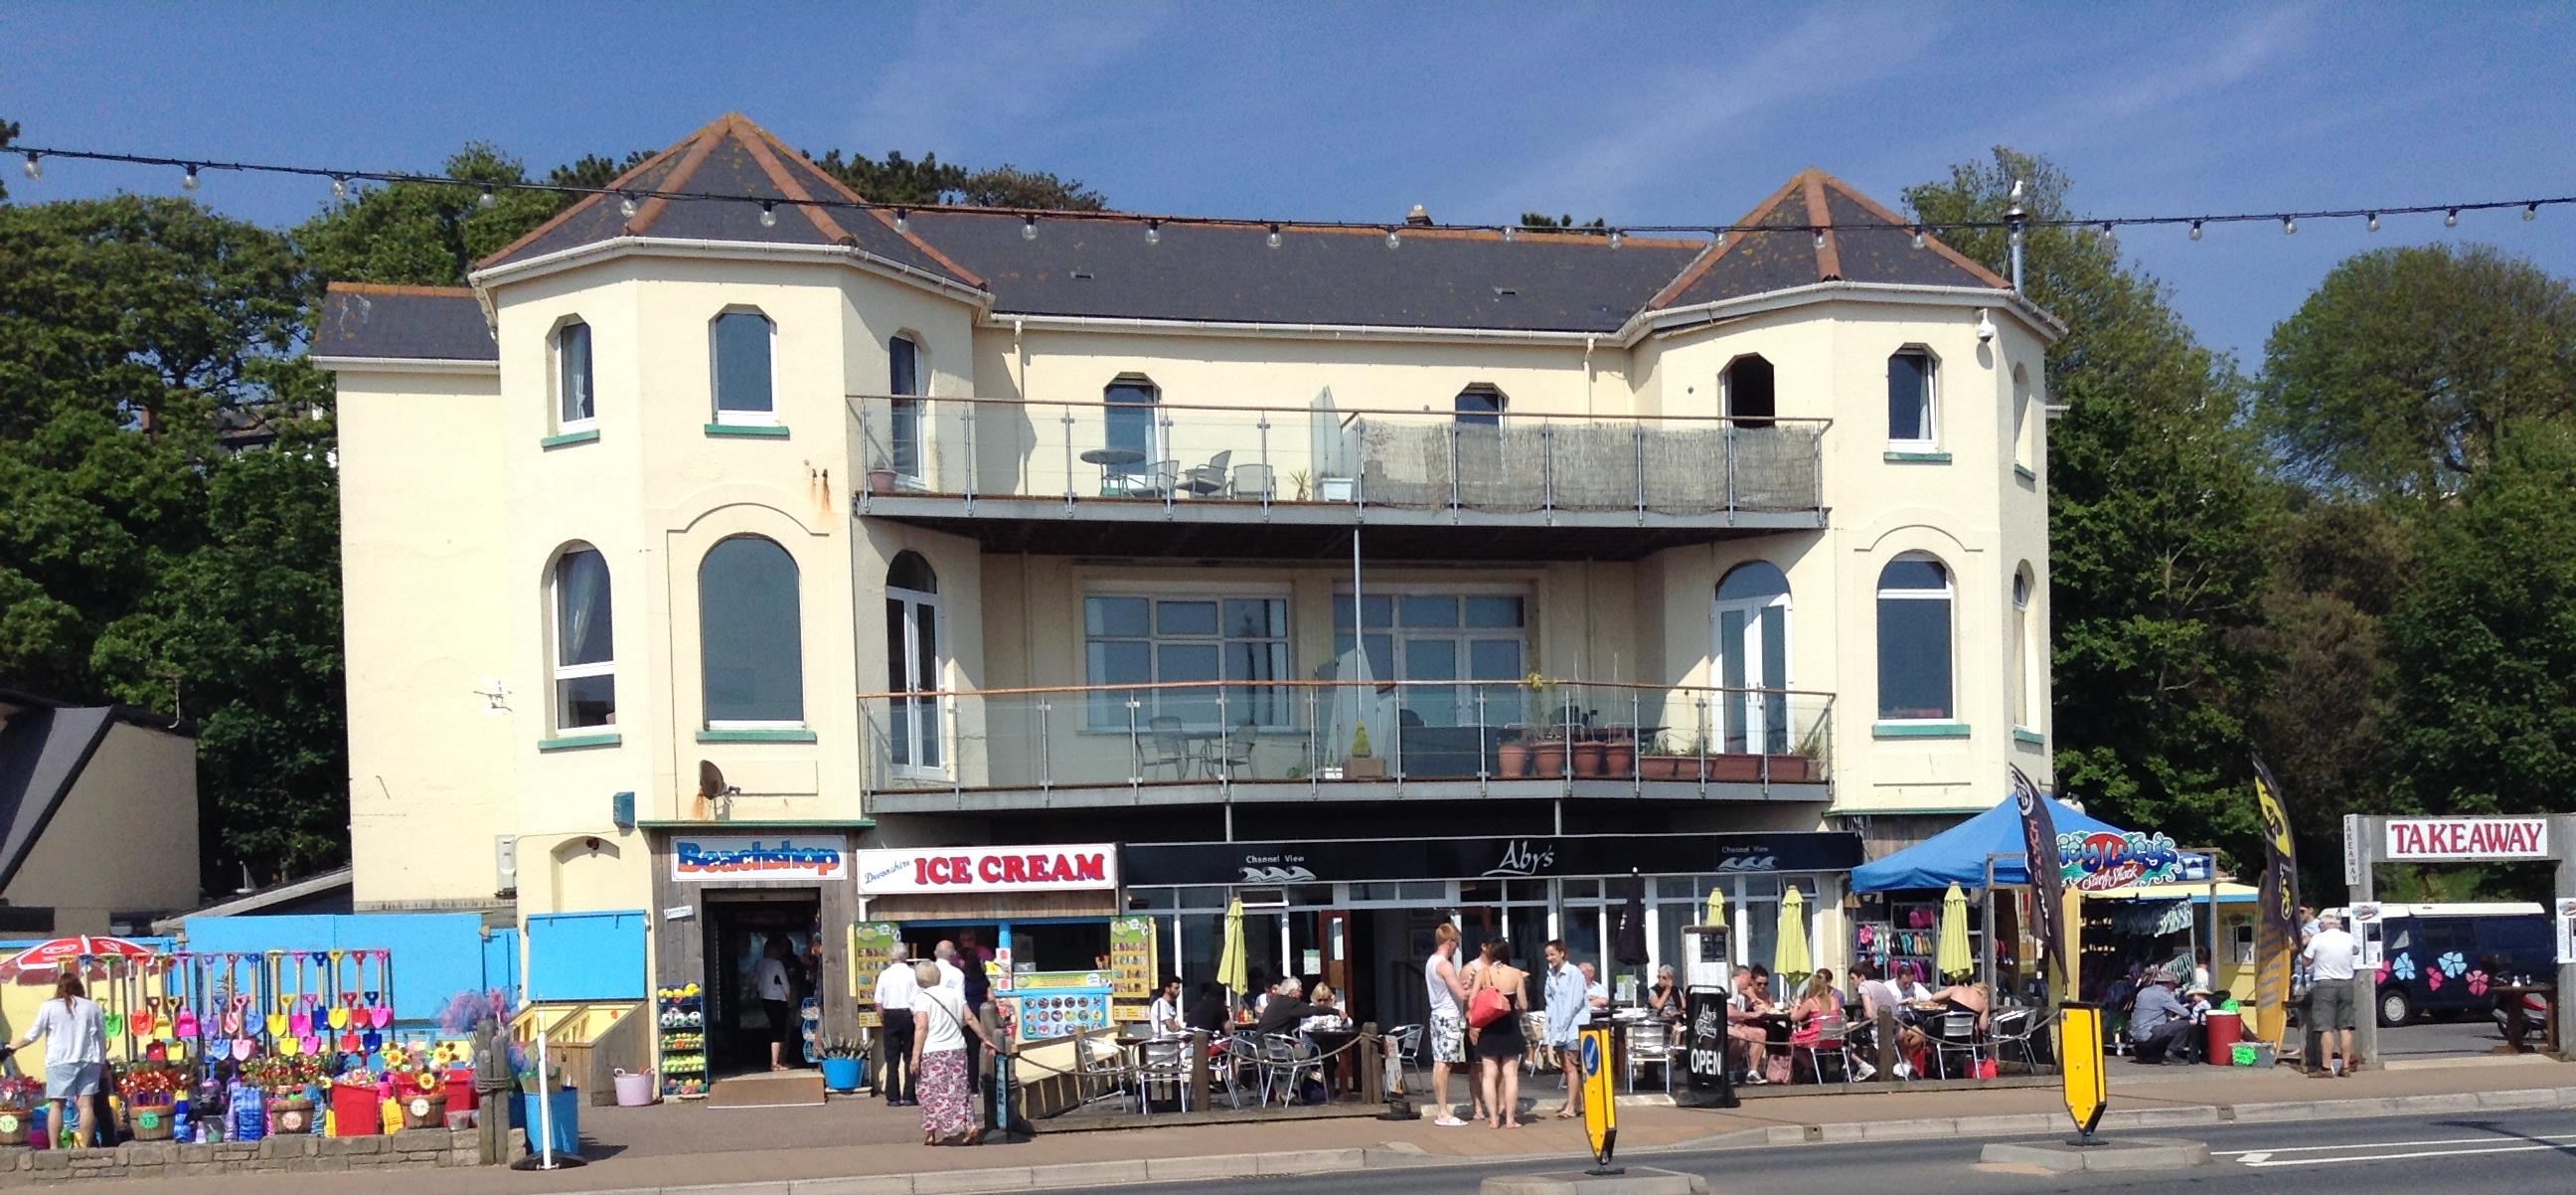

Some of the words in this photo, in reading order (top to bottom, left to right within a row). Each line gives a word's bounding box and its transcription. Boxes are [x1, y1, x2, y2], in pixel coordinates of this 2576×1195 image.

[2346, 816, 2356, 883] TAKEAWAY
[2391, 822, 2543, 854] TAKEAWAY
[677, 840, 840, 876] Beachshop
[914, 856, 973, 885] ICE
[978, 853, 1106, 884] CREAM
[1245, 855, 1280, 864] Channel
[1481, 839, 1554, 876] Aby's
[1690, 1048, 1721, 1076] OPEN
